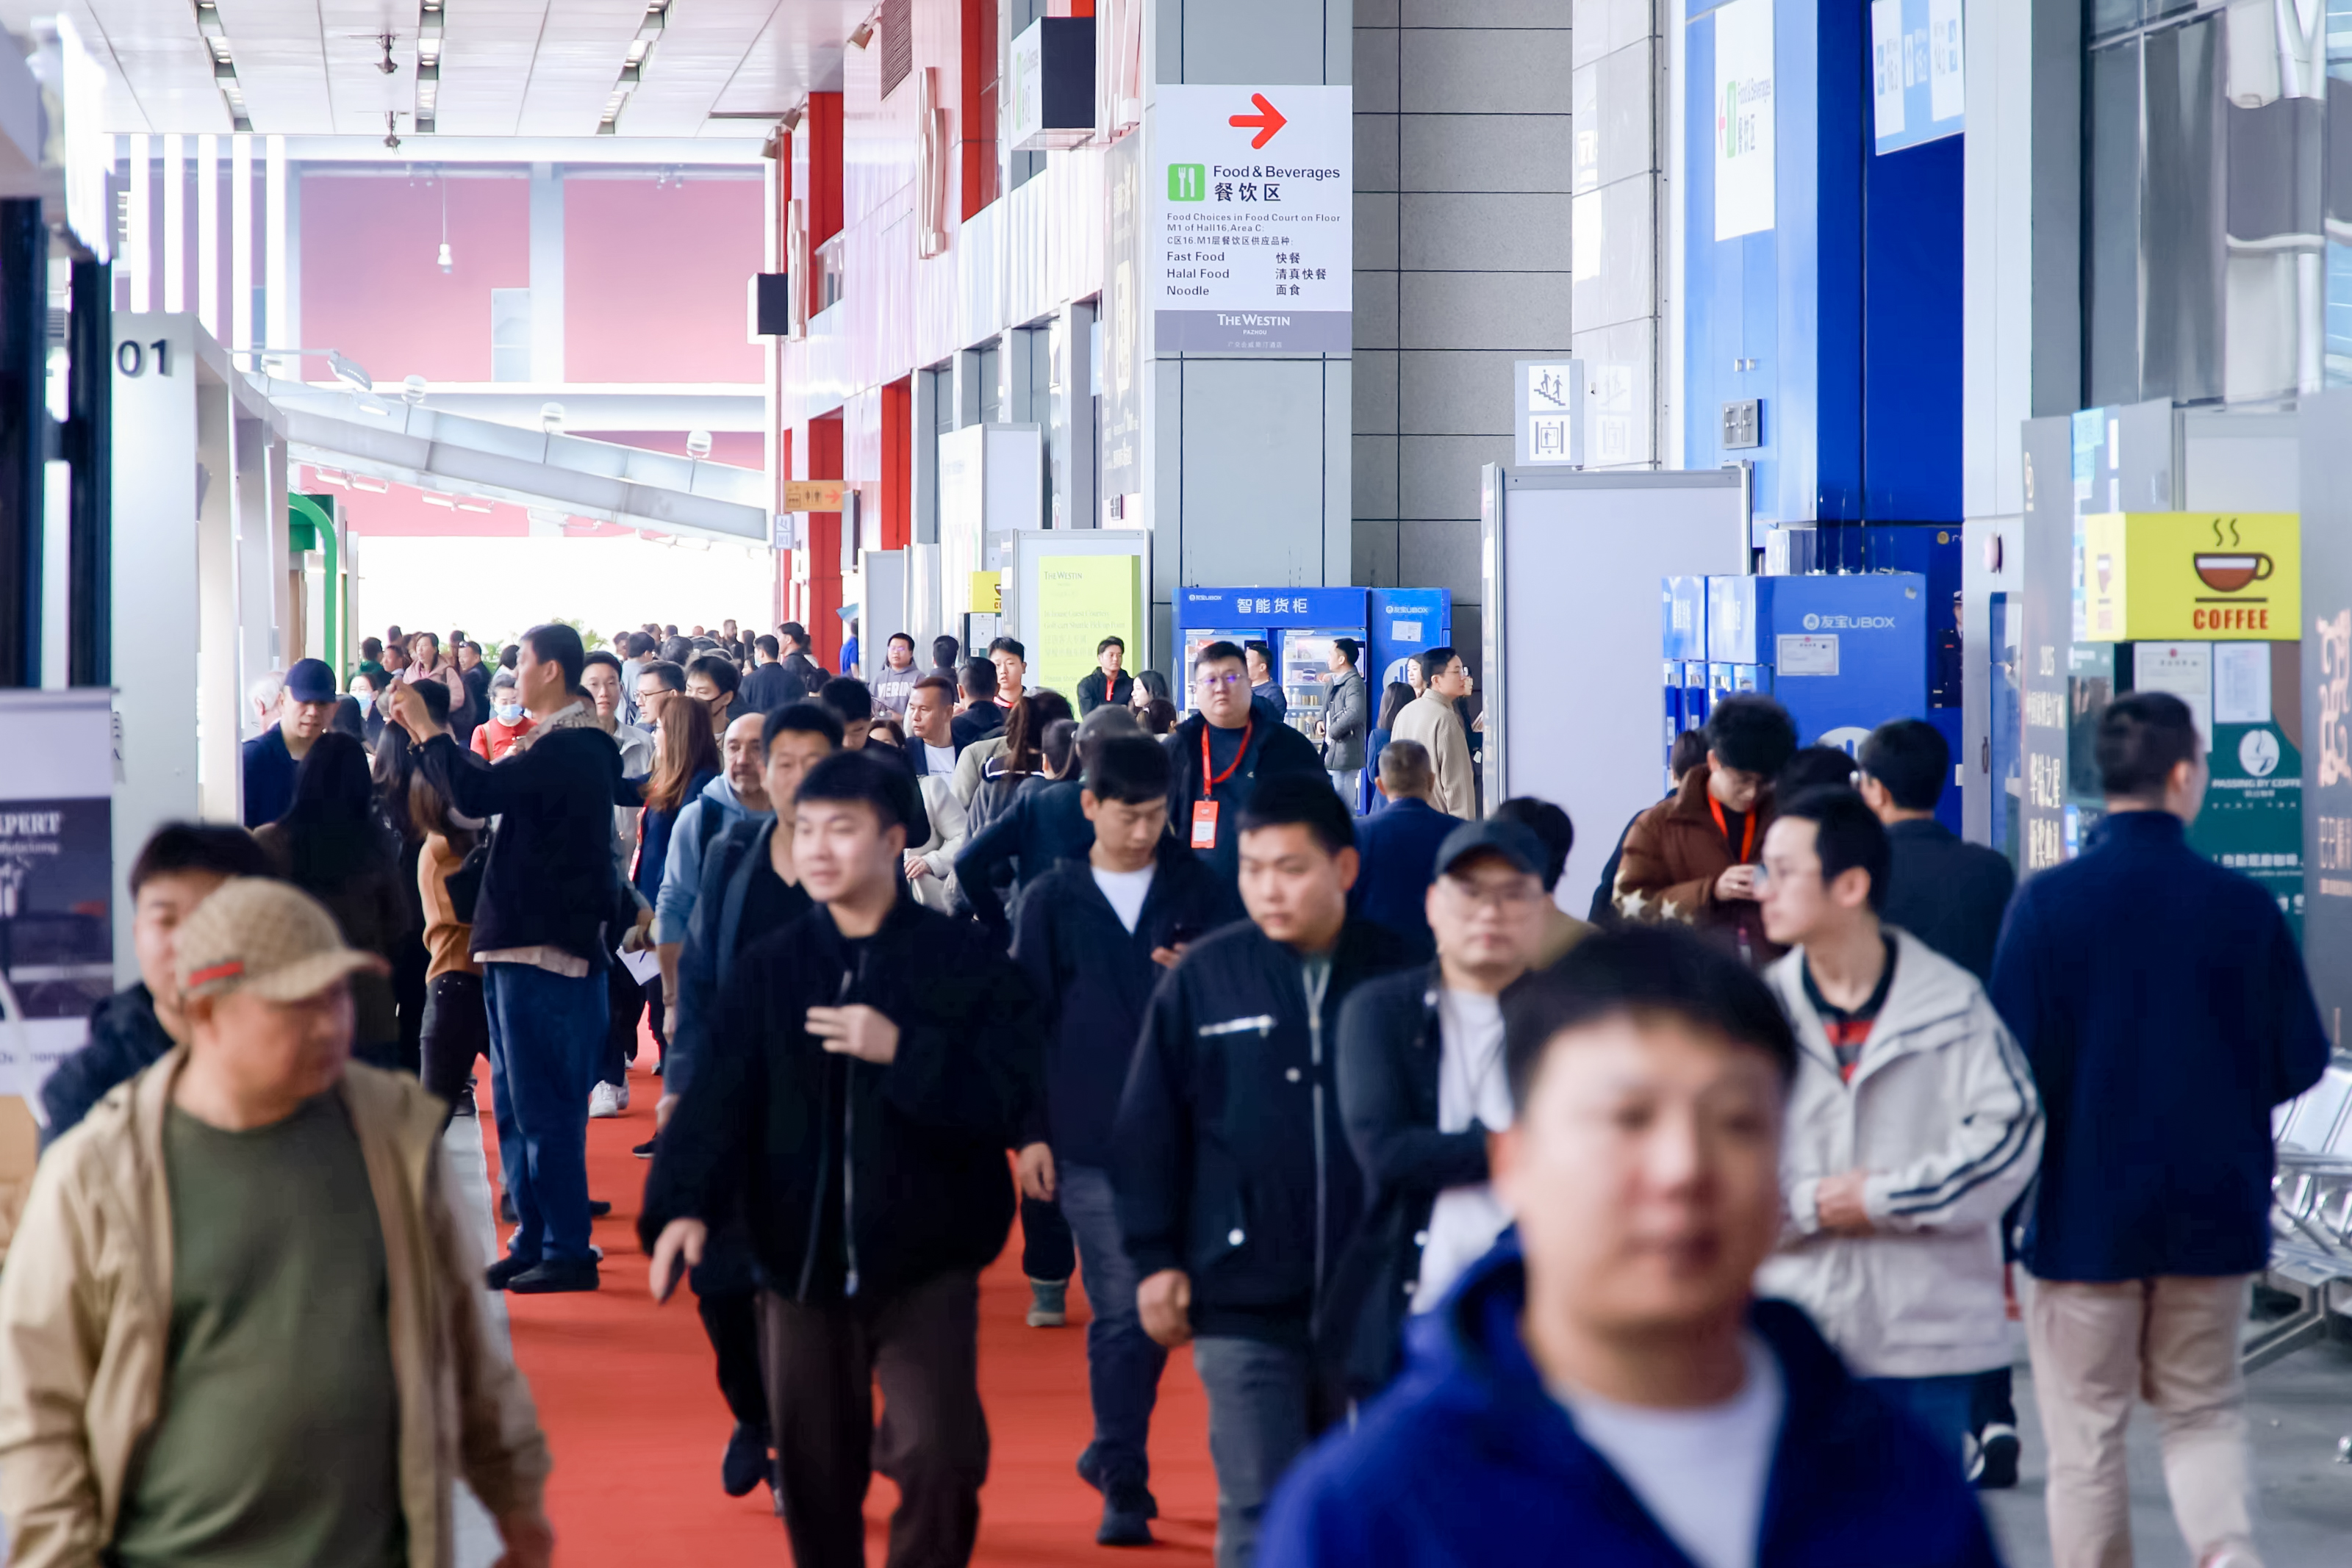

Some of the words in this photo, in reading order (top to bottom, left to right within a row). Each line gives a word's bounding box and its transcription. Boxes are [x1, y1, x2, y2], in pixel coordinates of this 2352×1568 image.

[1213, 165, 1249, 179] Food
[1252, 165, 1263, 179] &
[1265, 165, 1340, 181] Beverages
[1213, 182, 1281, 202] 餐饮区
[1167, 212, 1191, 221] Food
[1193, 212, 1231, 221] Choices
[1234, 213, 1242, 221] in
[1245, 213, 1269, 222] Food
[1272, 213, 1299, 222] Court
[1316, 214, 1341, 222] Floor
[1185, 223, 1194, 231] of
[1166, 251, 1191, 262] Fast
[1195, 251, 1225, 262] Food
[1276, 252, 1300, 264] 快餐
[1166, 269, 1196, 278] Halal
[1200, 269, 1230, 278] Food
[1275, 268, 1327, 280] 清真快餐
[1166, 285, 1209, 295] Noodle
[1275, 284, 1300, 296] 面食
[1217, 313, 1241, 326] THE
[1241, 313, 1290, 326] WESTIN
[116, 339, 168, 378] 01
[1237, 598, 1308, 614] 智能货柜
[2193, 608, 2269, 630] COFFEE
[2212, 778, 2256, 788] PASSING
[2256, 778, 2270, 788] BY
